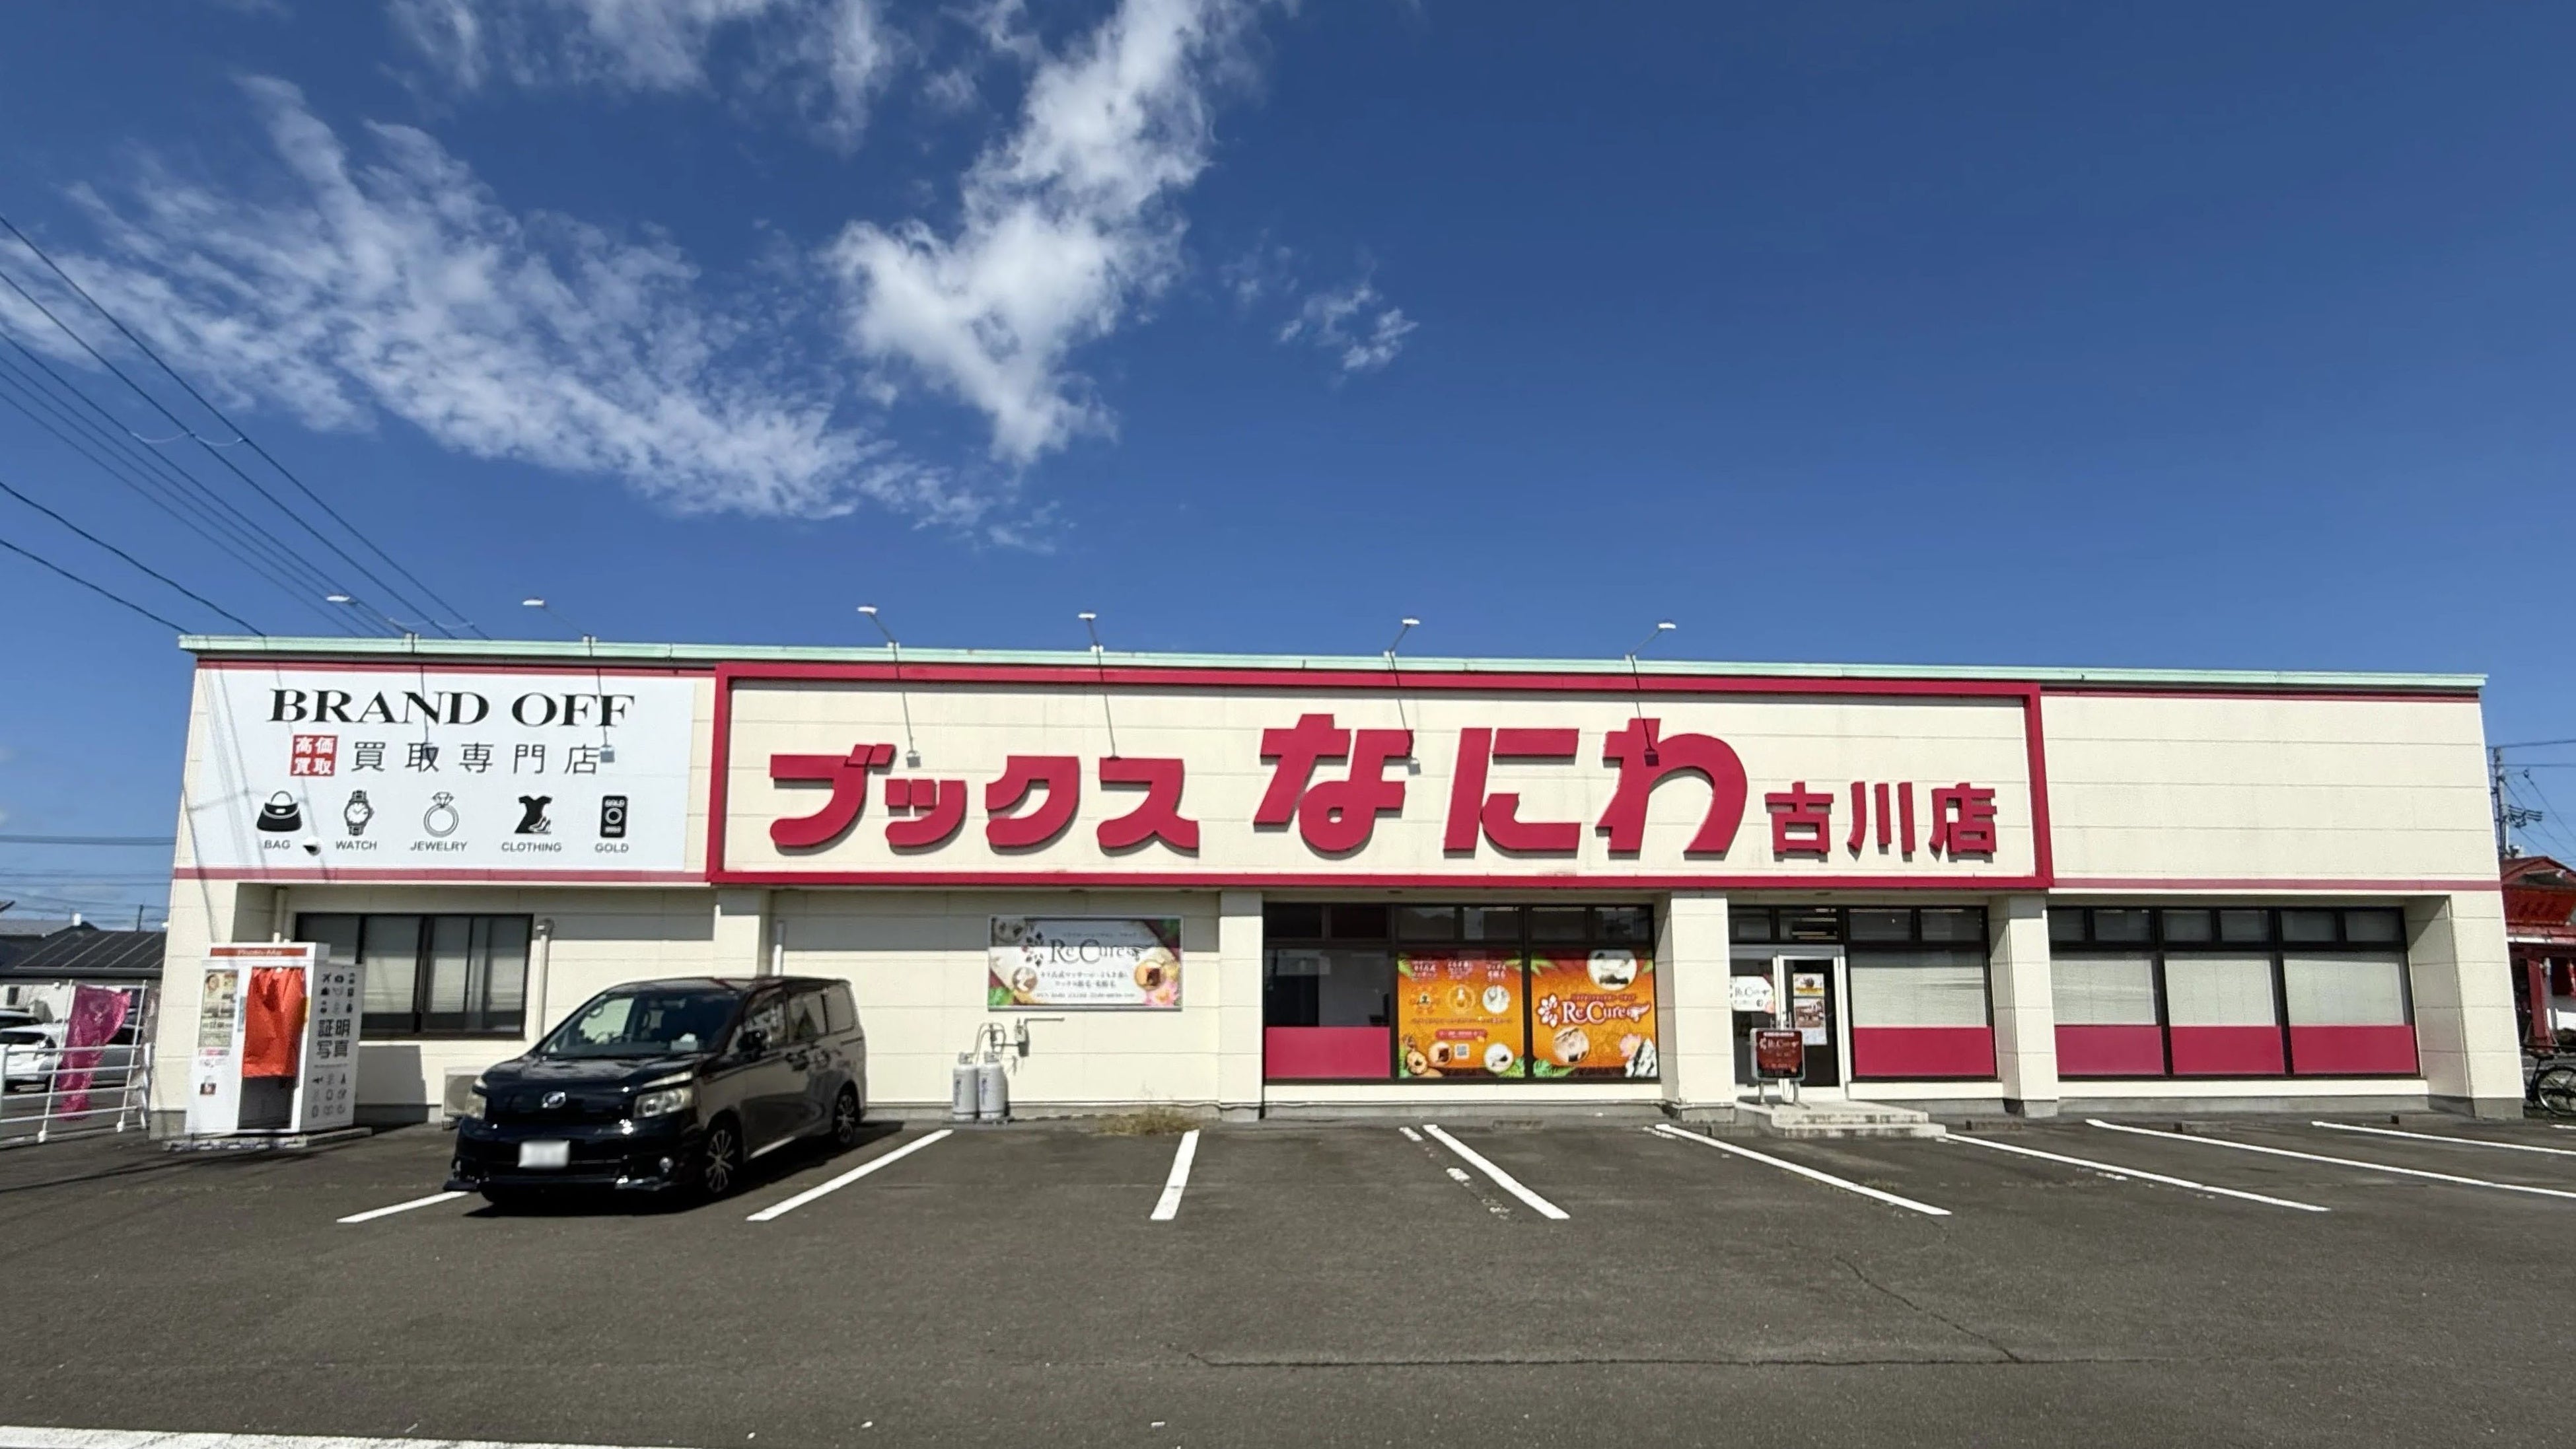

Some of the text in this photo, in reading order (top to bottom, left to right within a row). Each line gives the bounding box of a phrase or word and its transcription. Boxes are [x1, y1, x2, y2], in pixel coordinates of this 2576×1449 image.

[266, 688, 635, 727] BRAND OFF
[295, 737, 336, 754] 高価
[293, 758, 333, 775] 買取
[351, 741, 601, 775] 買取専門店
[769, 714, 1997, 859] ブックス なにわ 古川店
[264, 839, 291, 850] BAG
[336, 840, 377, 851] WATCH
[410, 841, 468, 852] JEWELRY
[501, 841, 562, 853] CLOTHING
[594, 843, 629, 853] GOLD
[318, 1018, 351, 1038] 証明
[316, 1040, 349, 1059] 写真
